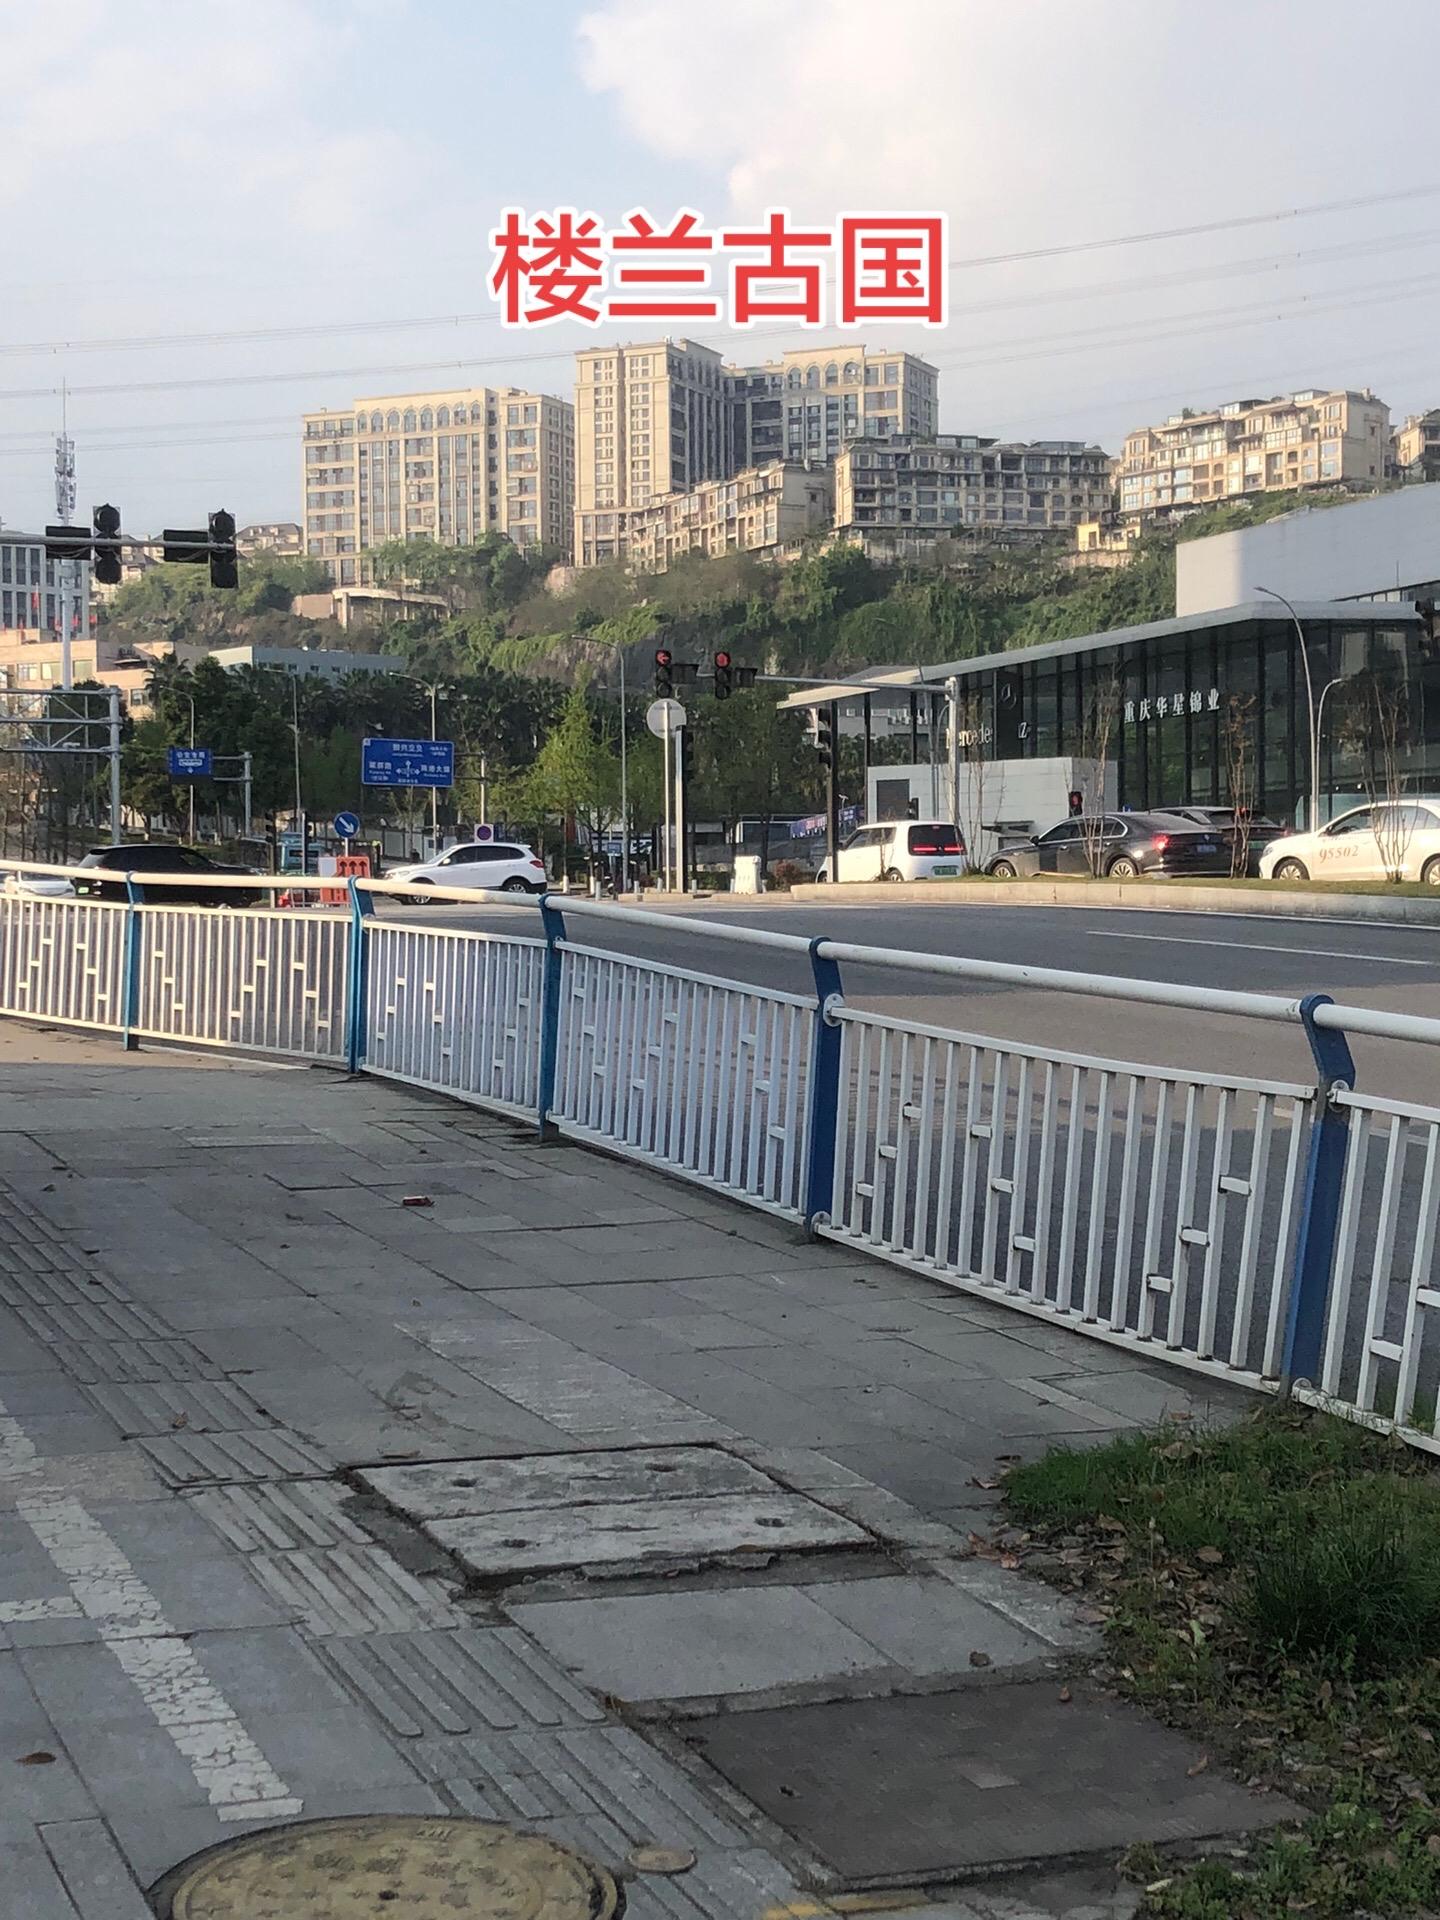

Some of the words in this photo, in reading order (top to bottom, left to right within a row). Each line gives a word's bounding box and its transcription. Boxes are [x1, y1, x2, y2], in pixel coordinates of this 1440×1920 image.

[1123, 687, 1220, 724] 重庆华星锦业
